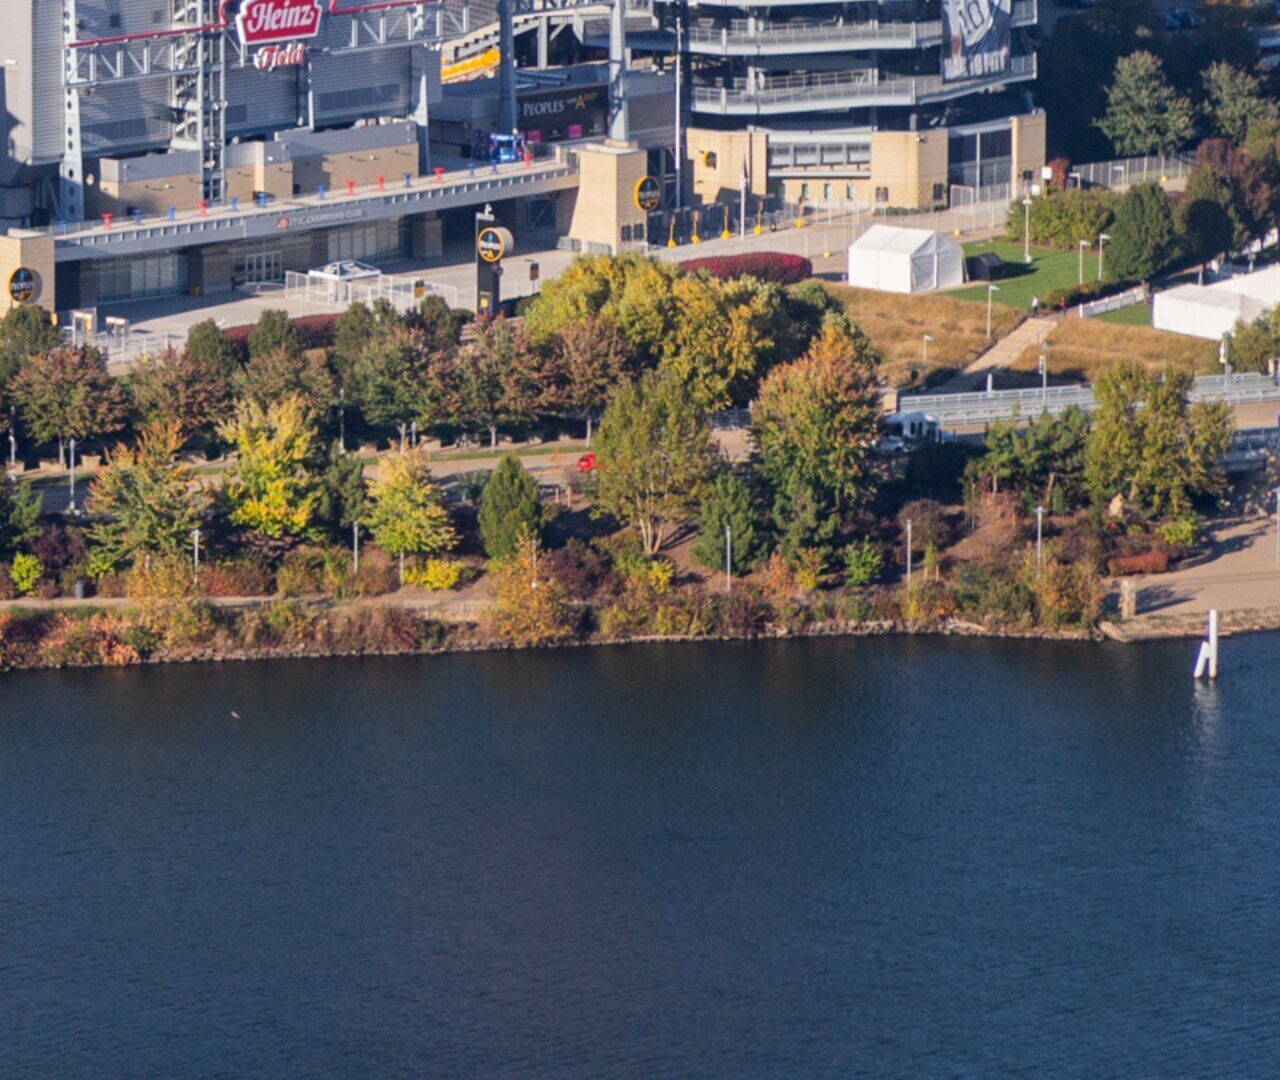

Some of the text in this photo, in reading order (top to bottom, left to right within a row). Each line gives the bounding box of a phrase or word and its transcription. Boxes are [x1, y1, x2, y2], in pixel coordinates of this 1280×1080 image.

[246, 0, 315, 33] Heinz
[253, 42, 304, 72] Field
[523, 100, 565, 117] PEOPLES
[576, 94, 585, 110] A
